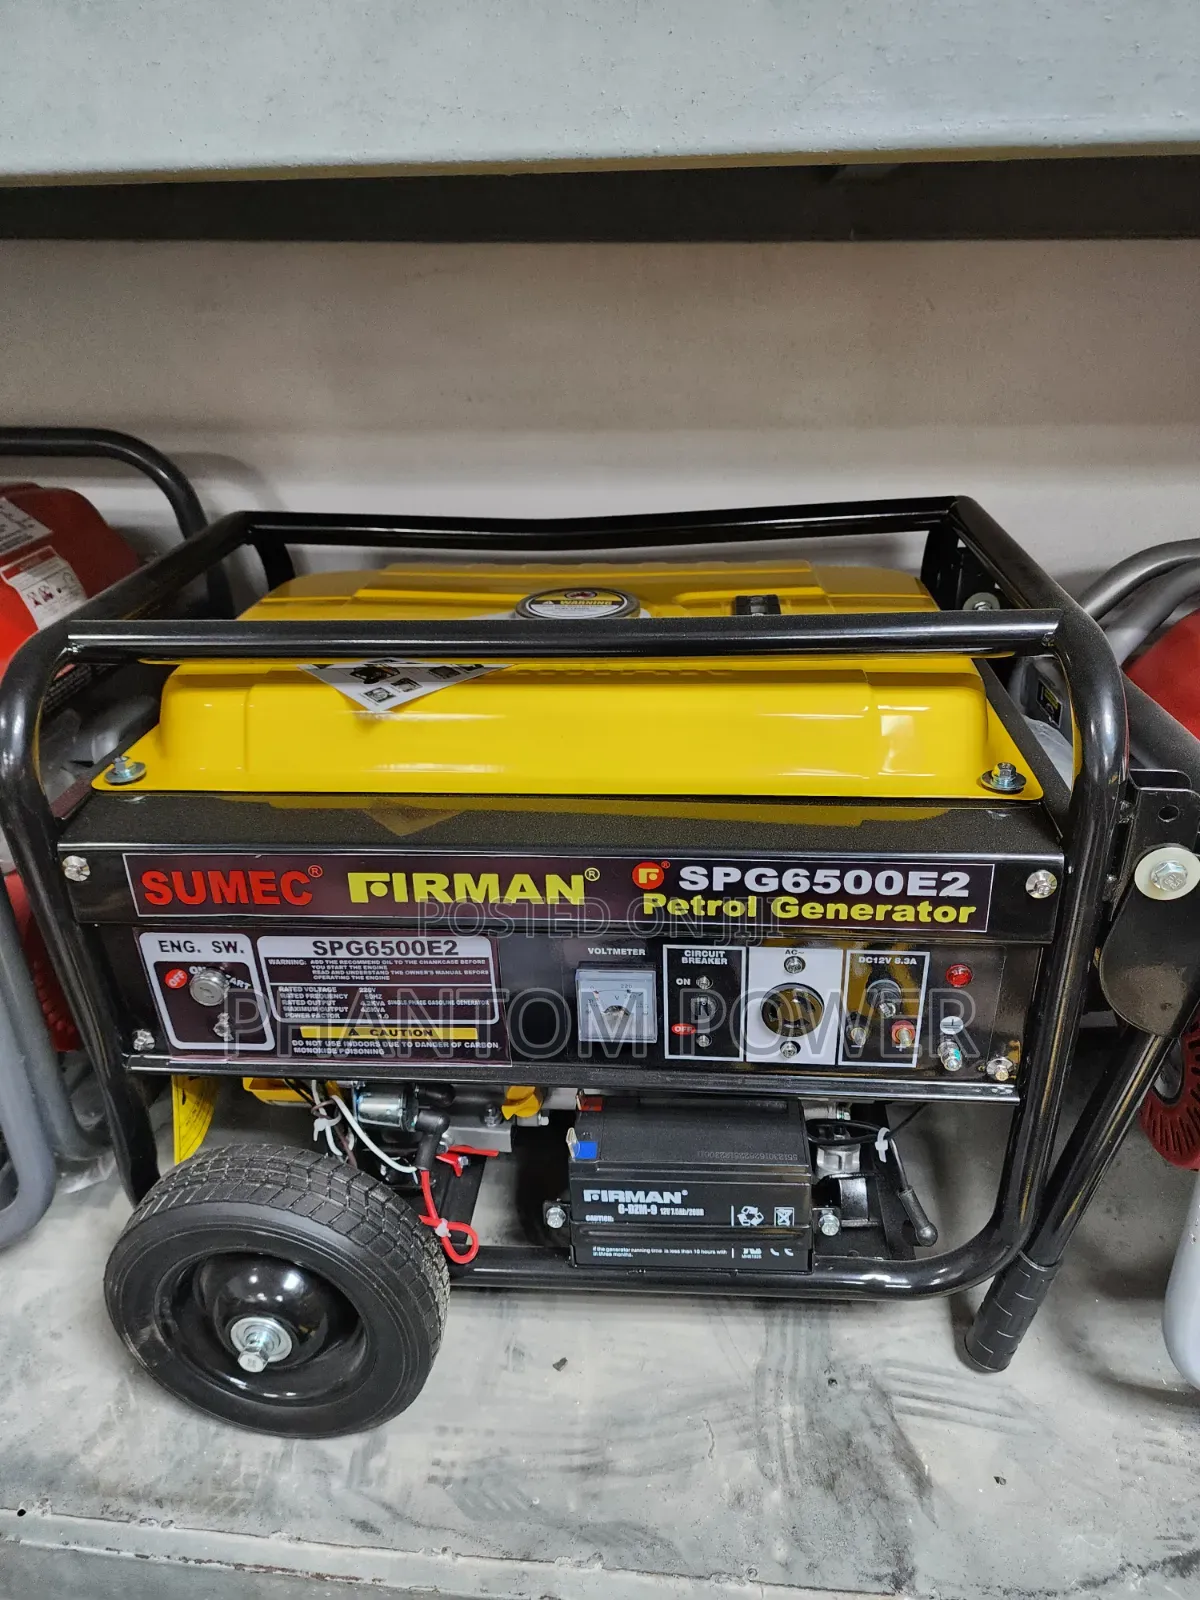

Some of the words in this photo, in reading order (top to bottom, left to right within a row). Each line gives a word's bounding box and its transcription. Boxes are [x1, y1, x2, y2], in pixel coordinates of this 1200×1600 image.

[679, 866, 970, 897] SPG6500E2
[643, 891, 757, 918] Petrol
[772, 898, 976, 924] Generator
[158, 940, 201, 953] ENG.
[212, 940, 245, 954] SW.
[312, 940, 459, 956] SPG6500E2
[684, 950, 725, 958] CIRCUIT
[681, 957, 728, 965] BREAKER
[858, 956, 890, 965] DC12V
[894, 957, 917, 966] 8.3A
[168, 970, 186, 987] OFF
[675, 978, 691, 986] ON
[370, 1028, 433, 1037] CAUTION
